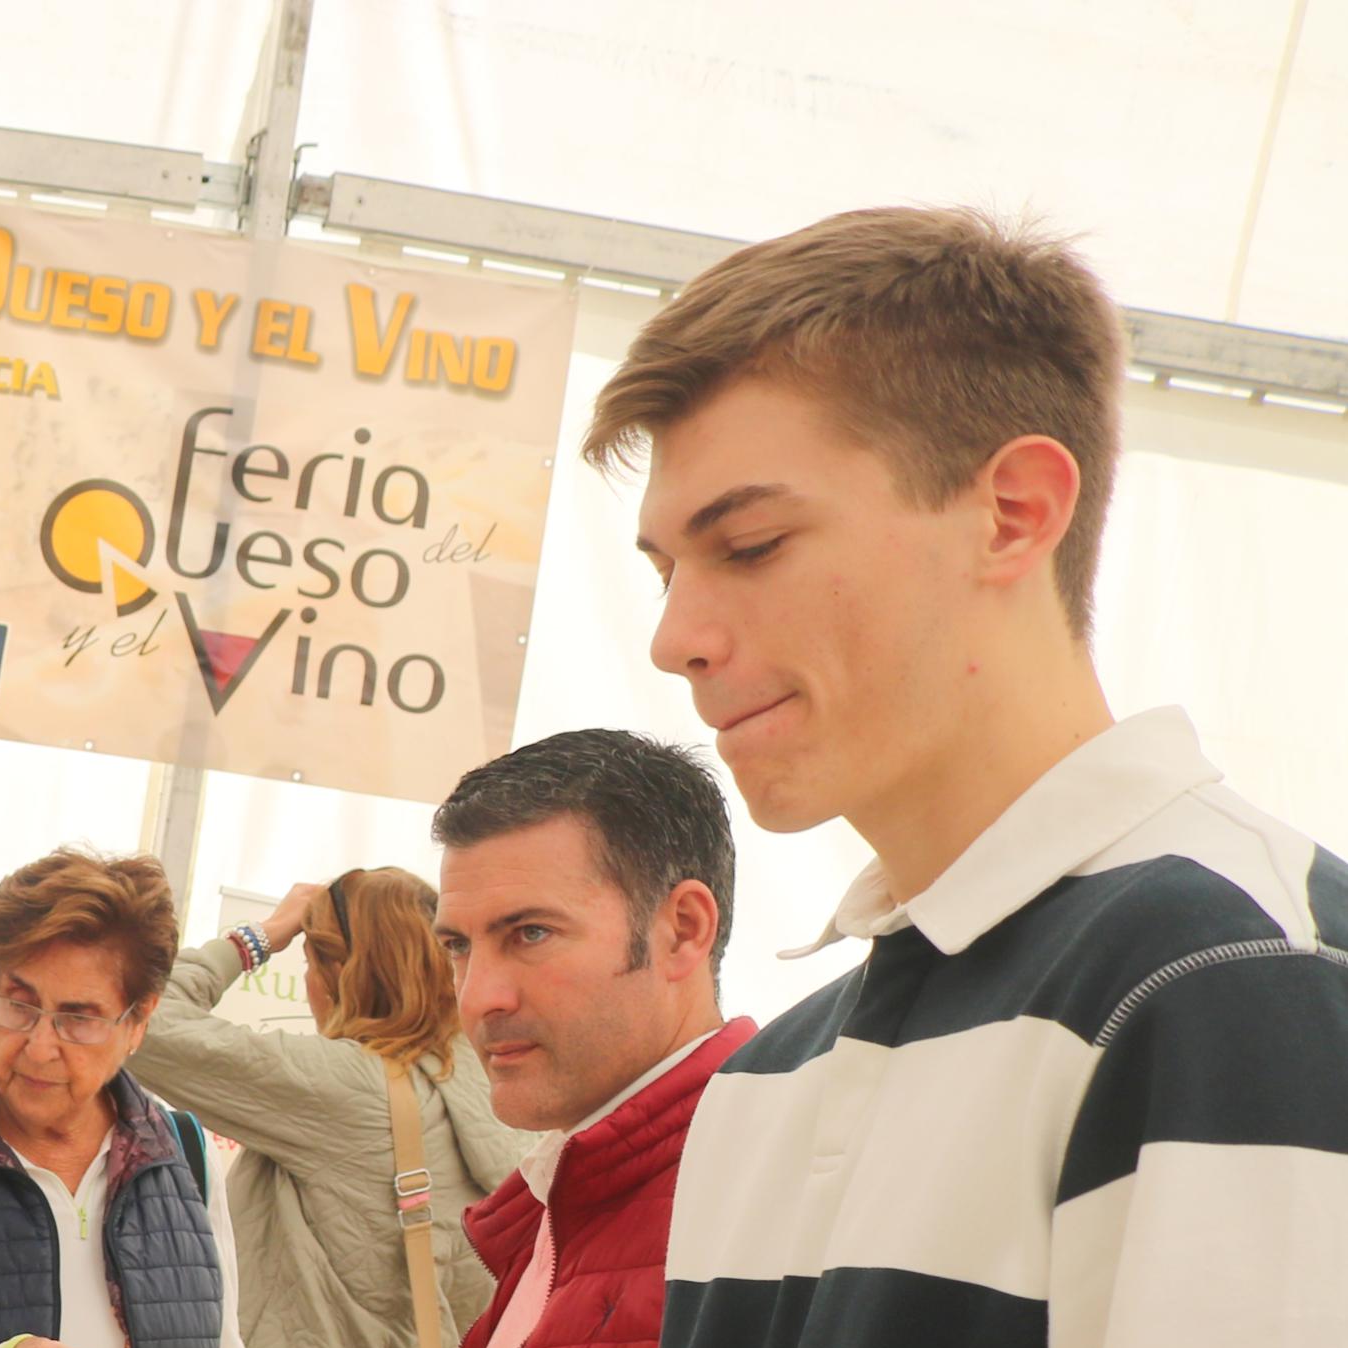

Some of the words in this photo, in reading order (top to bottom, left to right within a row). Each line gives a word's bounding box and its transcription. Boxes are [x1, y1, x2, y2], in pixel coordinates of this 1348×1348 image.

[192, 288, 241, 350] Y
[422, 521, 498, 566] del
[62, 623, 101, 669] y
[109, 607, 168, 659] el
[173, 588, 447, 717] Vino
[239, 962, 309, 1003] Ru
